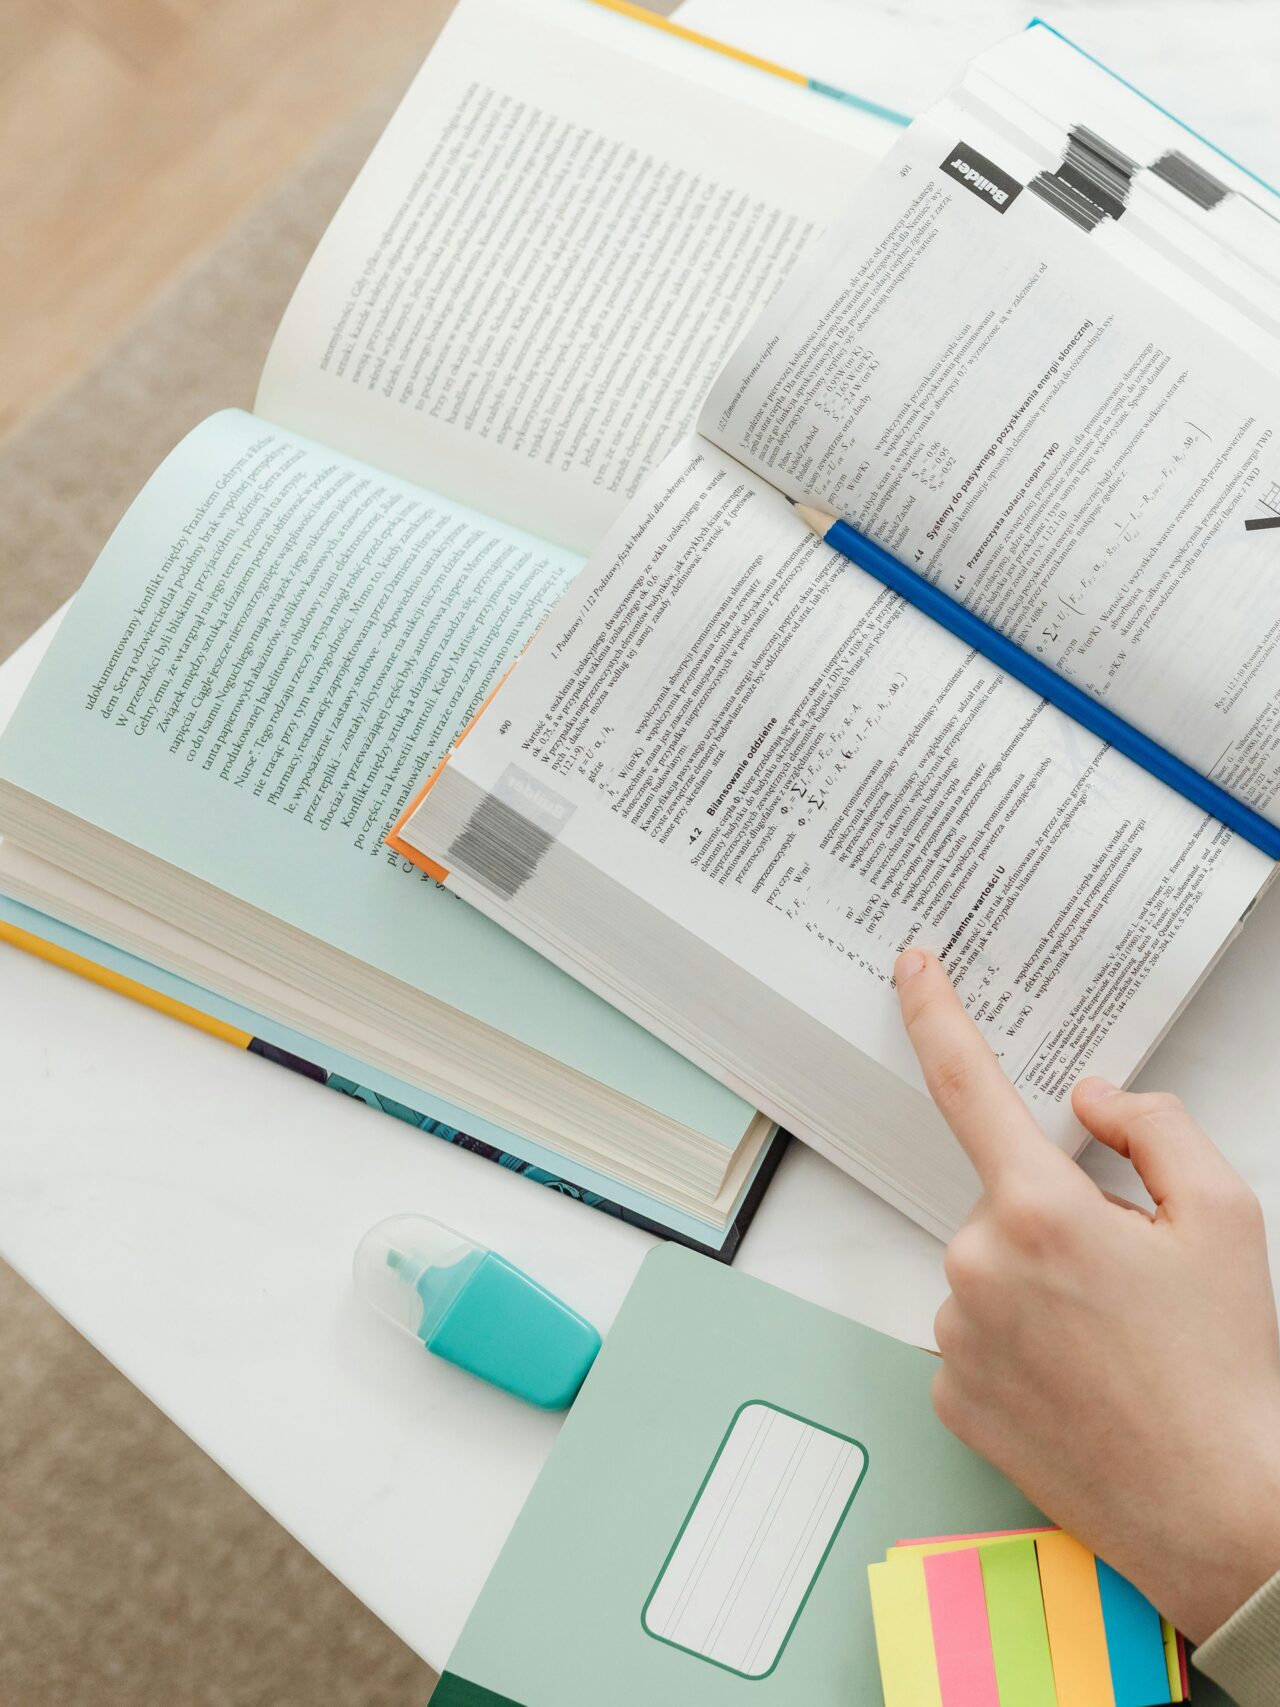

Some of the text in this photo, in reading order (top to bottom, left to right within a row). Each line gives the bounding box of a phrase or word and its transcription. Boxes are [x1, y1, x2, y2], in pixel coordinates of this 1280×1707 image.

[899, 163, 912, 177] 491
[950, 158, 1009, 205] Builder
[882, 309, 996, 457] współczynnik pozyskiwania promieniowania
[912, 317, 1094, 565] -4.4 Systemy do pasywnego pozyskiwania energii słonecznej
[954, 378, 1067, 523] kombinacje opisanych elementów prowadzą
[554, 473, 686, 652] Podstawy Podstawy fizyki budowli dla ochrony
[953, 441, 1059, 592] -4.4.1 Przezroczysta izolacja cieplna TWD
[84, 535, 189, 710] udokumentowany konflikt między
[99, 542, 206, 719] dem Serrą odzwierciedlał podobny
[125, 654, 161, 716] przeszłości
[173, 613, 206, 662] wtargnął
[196, 616, 272, 735] Isamu Noguchiego mają
[218, 570, 339, 781] produkowanej bakelitowej obudowy niani
[520, 500, 700, 750] Wartość oszklenia izolacyjnego dwuszynowego szkła izolacyjnego
[548, 526, 710, 757] przypadku nieprzezroczystych elementów budynków, jak zwykłych
[550, 524, 724, 771] nych dachów można według samej zasady zdefiniować wartość
[561, 599, 641, 715] przypadku szklenia izolacyjnego
[610, 577, 777, 813] Powszechnie znana jest znacznie mniejsza możliwość odzyskiwania
[634, 553, 763, 734] współczynnik absorpcji promieniowania słonecznego
[644, 577, 761, 742] współczynnik przejmowania ciepła zewnątrz
[265, 592, 391, 806] Pharmacy, restaurację zaprojektowaną przez
[292, 646, 380, 800] wyposażenie zastawy stołowe
[339, 610, 466, 828] Konflikt między sztuką dizajnem zasadza
[384, 623, 479, 782] kwestii kontroli. Matisse
[498, 719, 512, 735] 490
[586, 760, 604, 784] gdzie
[395, 749, 433, 807] malowidła,
[629, 742, 689, 825] mentami budowlanymi.
[688, 716, 777, 845] -4.2 Bilansowanie oddzielne
[689, 734, 785, 866] Strumienie ciepła które przedostają
[818, 758, 883, 850] natężenie promieniowania
[858, 692, 989, 877] skuteczny całkowity współczynnik przepuszczalności
[734, 823, 778, 884] przezroczystych:
[971, 864, 1005, 911] wartości U
